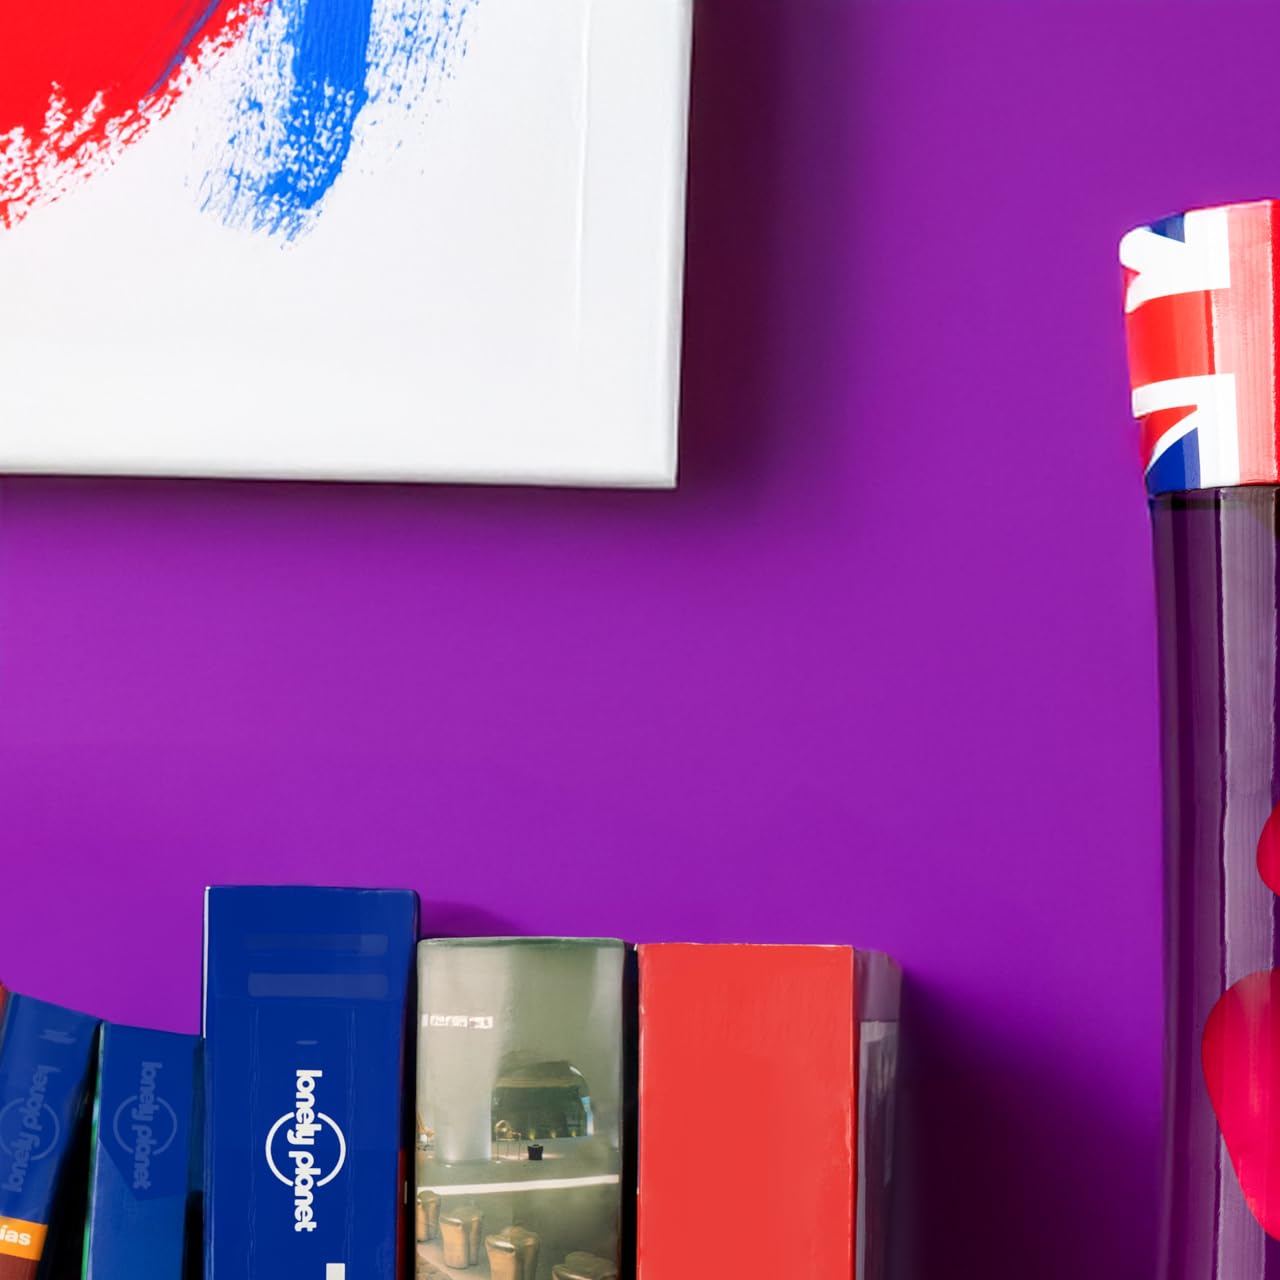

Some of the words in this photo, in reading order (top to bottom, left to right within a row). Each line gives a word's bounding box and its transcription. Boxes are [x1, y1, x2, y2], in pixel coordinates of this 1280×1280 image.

[132, 1061, 163, 1121] lonely
[286, 1069, 323, 1145] lonely
[132, 1125, 158, 1190] planet
[288, 1150, 322, 1232] planet
